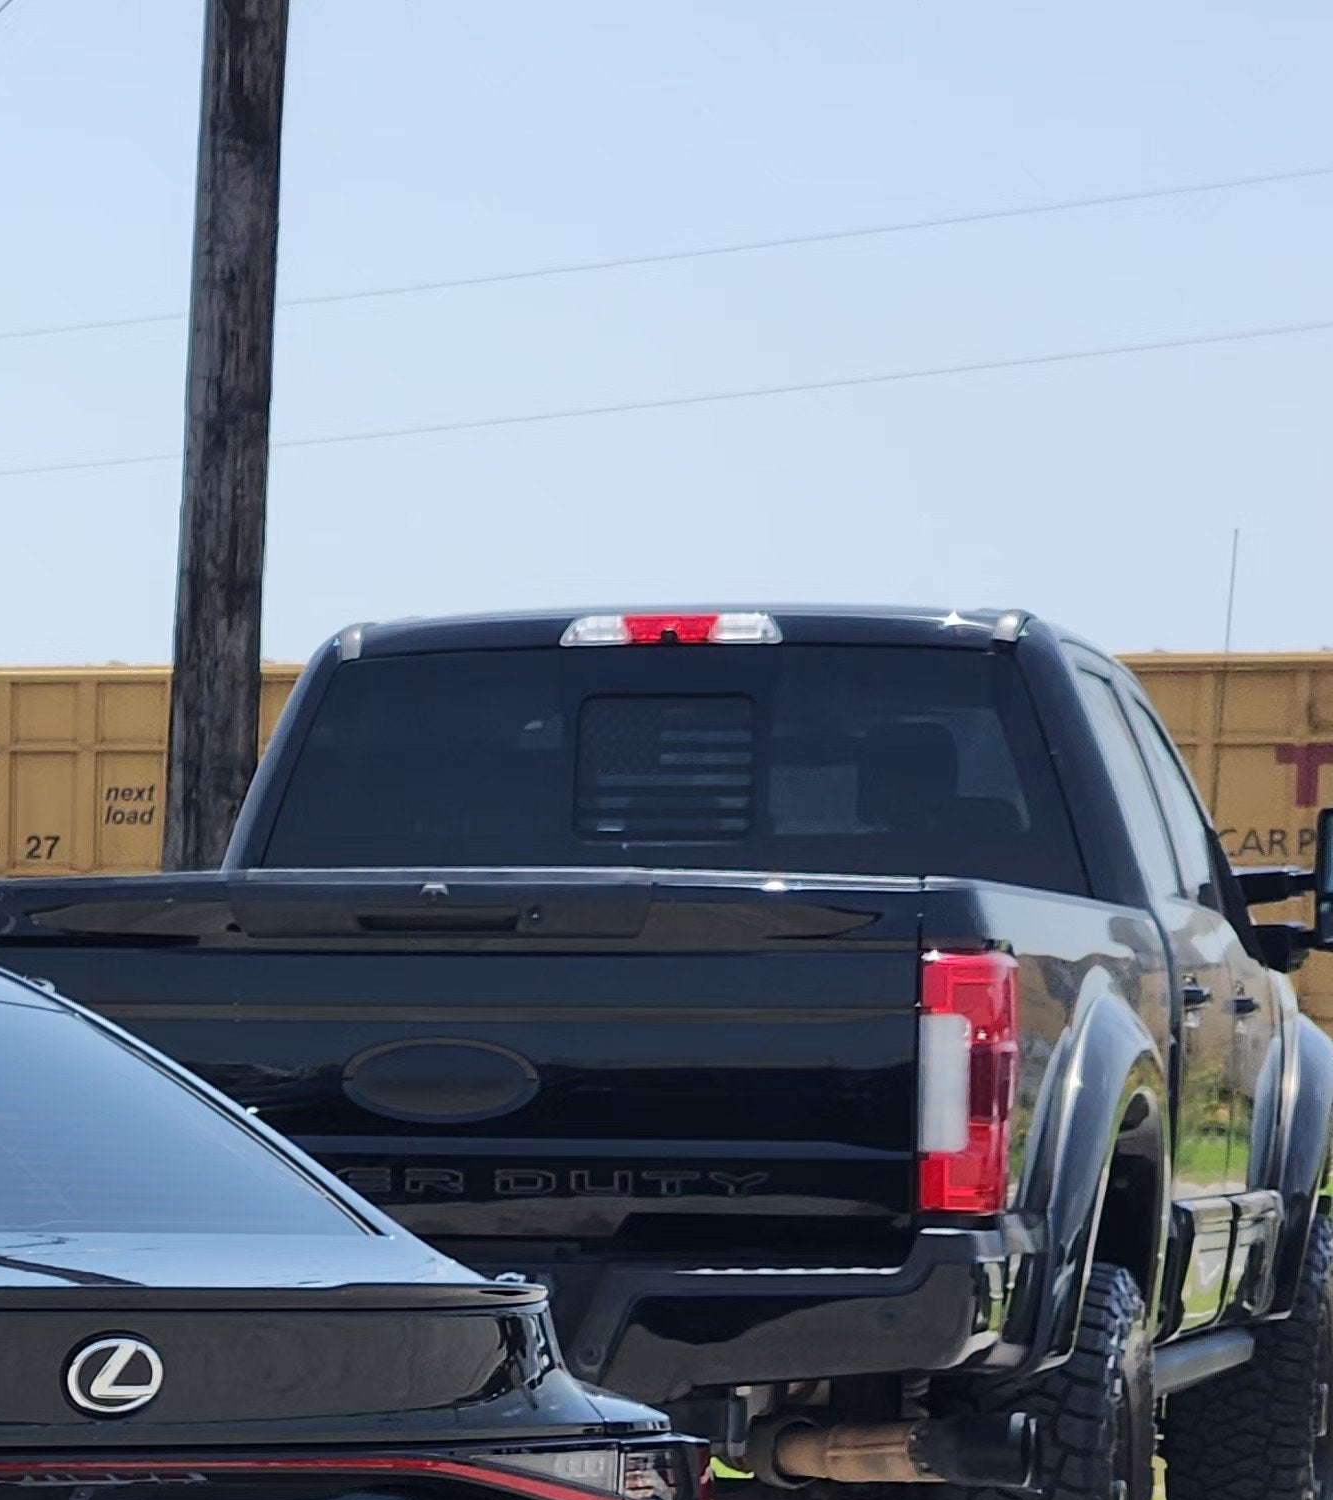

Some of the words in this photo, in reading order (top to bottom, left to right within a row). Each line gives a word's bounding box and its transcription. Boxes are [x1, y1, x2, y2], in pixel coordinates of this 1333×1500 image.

[105, 784, 156, 801] next
[104, 805, 155, 825] load
[494, 1168, 770, 1198] DUTY
